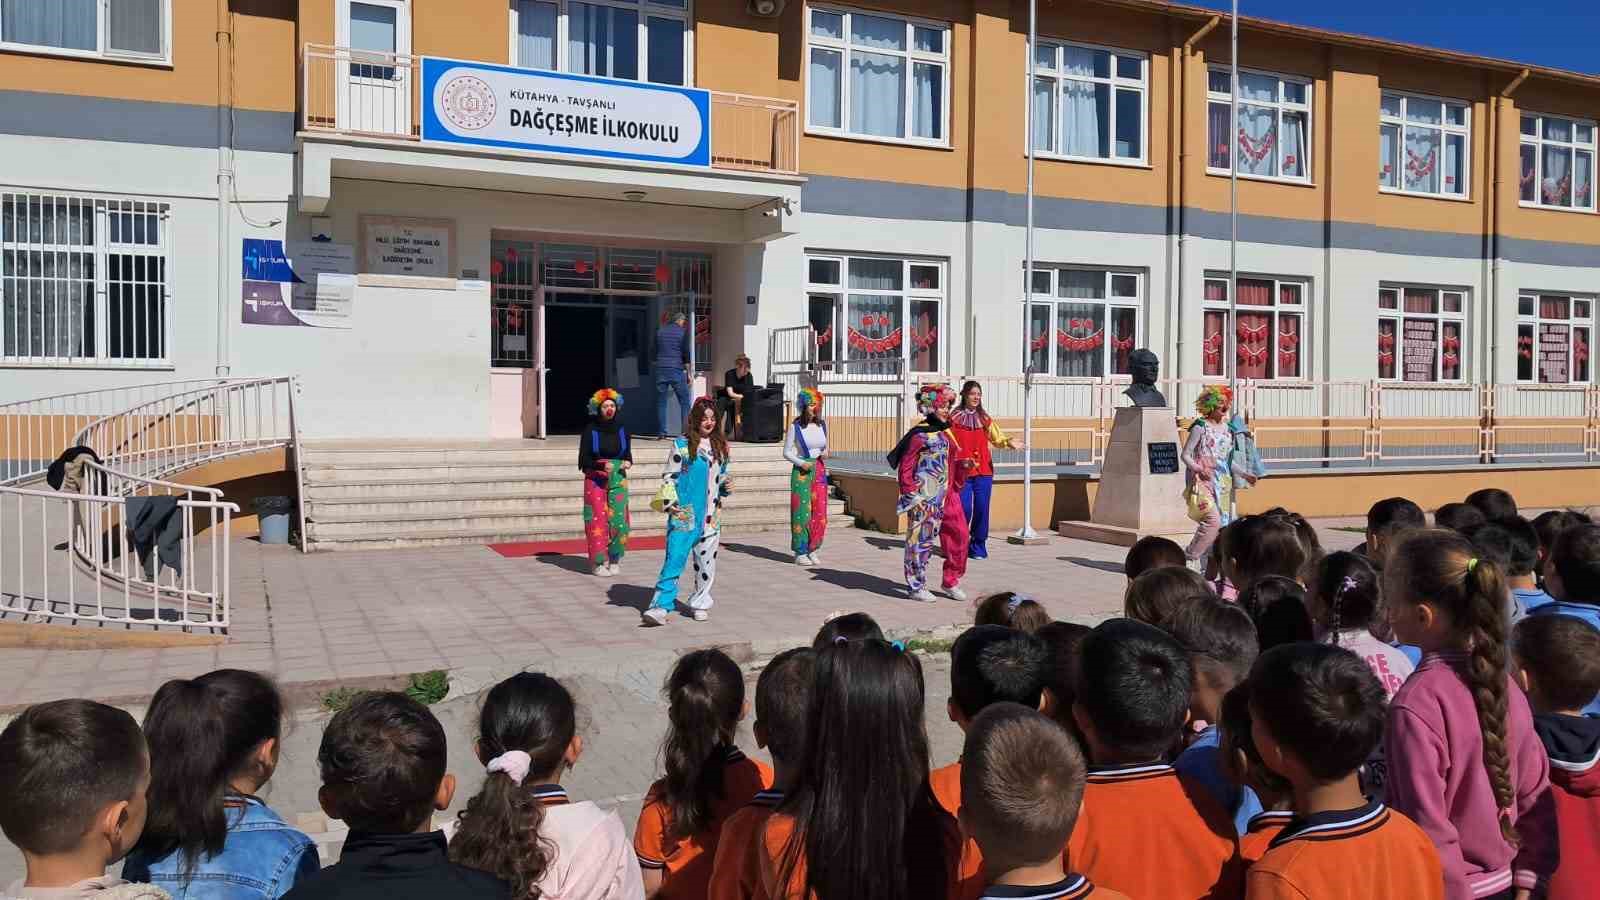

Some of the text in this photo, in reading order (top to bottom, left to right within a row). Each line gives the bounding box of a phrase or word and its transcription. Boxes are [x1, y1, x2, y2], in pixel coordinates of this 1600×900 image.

[510, 89, 559, 104] KÜTAHYA
[567, 96, 616, 110] TAVŞANLI
[509, 107, 680, 143] DAĞÇEŞME İLKOKULU
